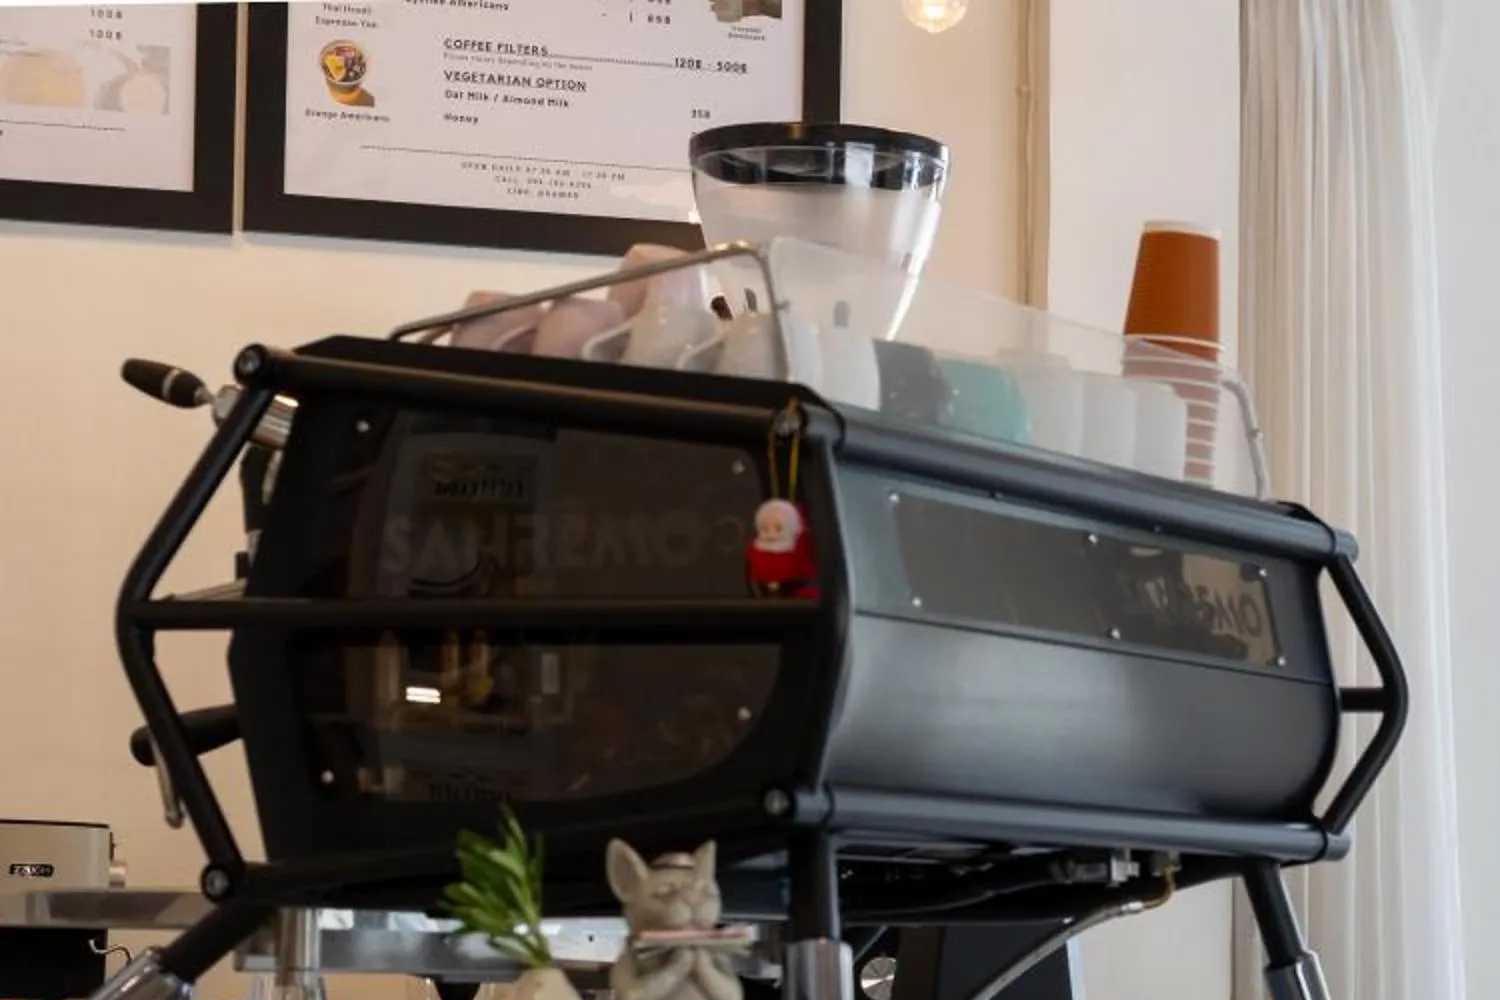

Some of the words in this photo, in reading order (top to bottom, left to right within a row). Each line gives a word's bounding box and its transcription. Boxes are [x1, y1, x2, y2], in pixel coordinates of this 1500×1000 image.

[443, 38, 492, 52] COFFEE
[497, 42, 549, 57] FILTERS
[443, 70, 532, 87] VEGETARIAN
[535, 77, 588, 92] OPTION
[467, 91, 489, 101] Milk
[502, 95, 544, 105] Almond
[547, 98, 569, 107] Milk
